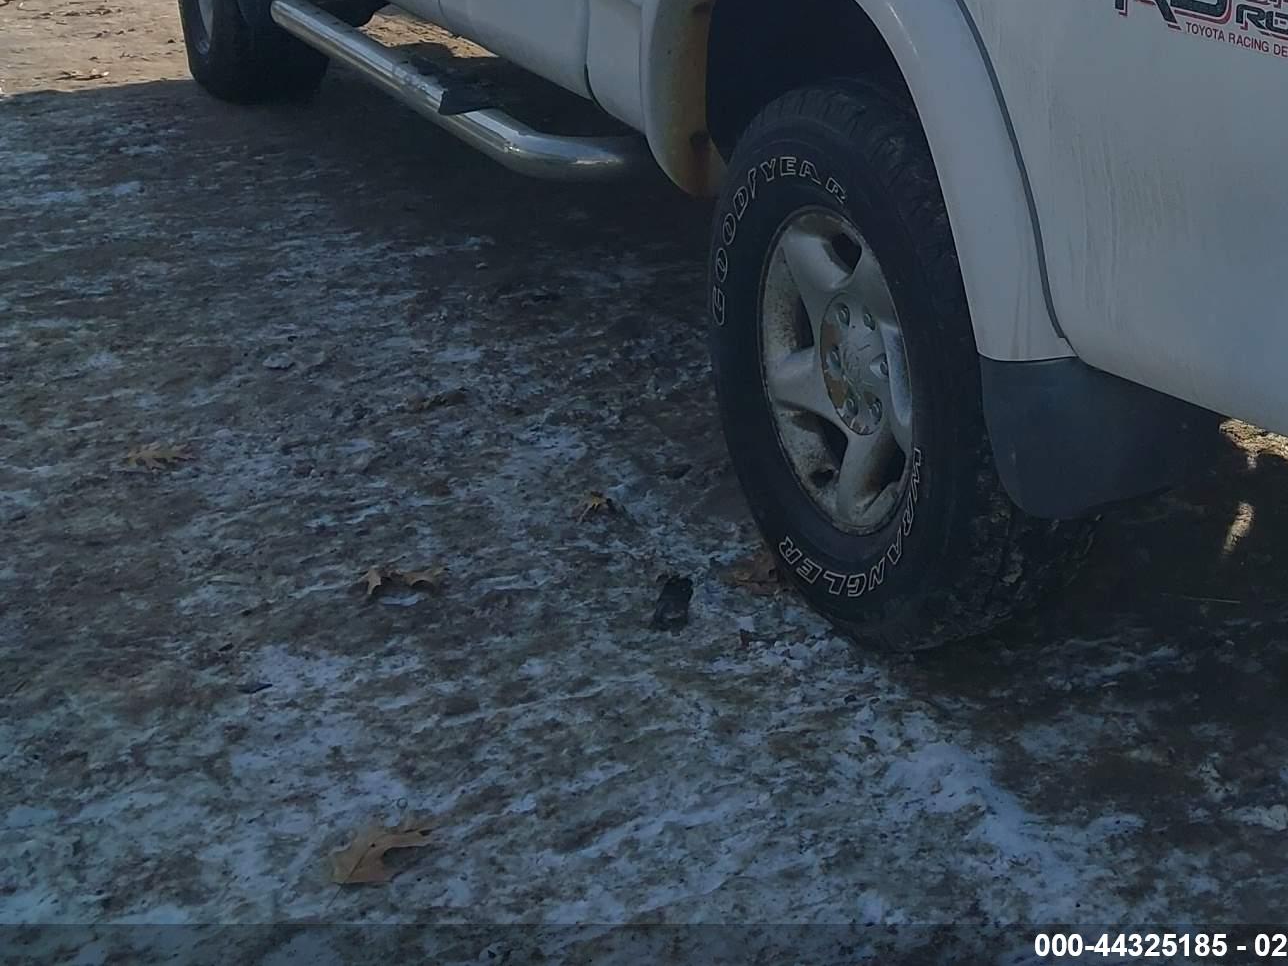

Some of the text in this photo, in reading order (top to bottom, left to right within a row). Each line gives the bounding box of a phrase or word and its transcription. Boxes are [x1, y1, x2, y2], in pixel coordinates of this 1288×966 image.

[1185, 20, 1226, 42] TOYOTA
[1228, 32, 1270, 53] RACING
[712, 155, 848, 326] GOODYEAR
[778, 447, 922, 597] WRANGLER
